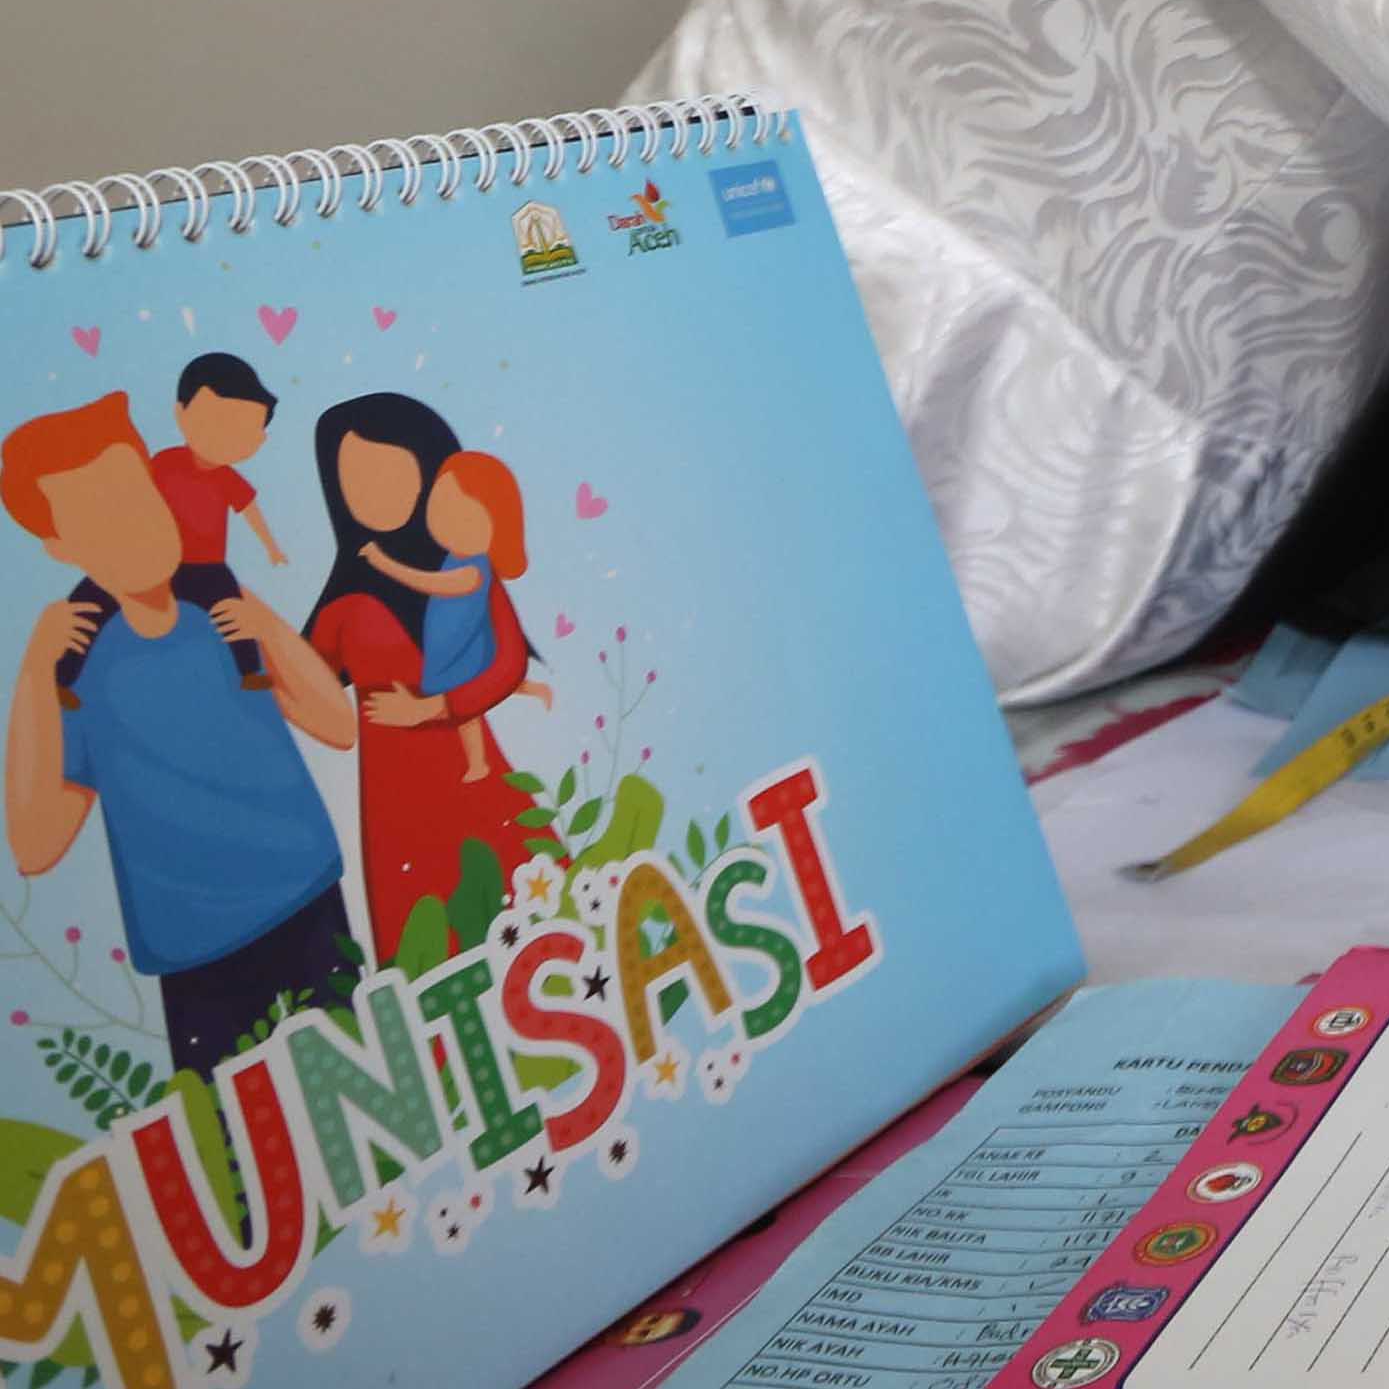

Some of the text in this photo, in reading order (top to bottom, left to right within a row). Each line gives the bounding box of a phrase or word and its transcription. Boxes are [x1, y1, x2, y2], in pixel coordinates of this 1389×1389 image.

[1112, 1057, 1183, 1071] KARTU
[988, 1169, 1041, 1182] LAHIR
[890, 1224, 987, 1245] NIK BALITA
[867, 1244, 950, 1263] BB LAHIR
[845, 1265, 982, 1291] BUKU KIA/KMS
[821, 1286, 863, 1303] IMD
[798, 1311, 916, 1338] NAMA AYAH
[770, 1336, 865, 1358] NIK AYAH
[812, 1369, 872, 1387] ORTU
